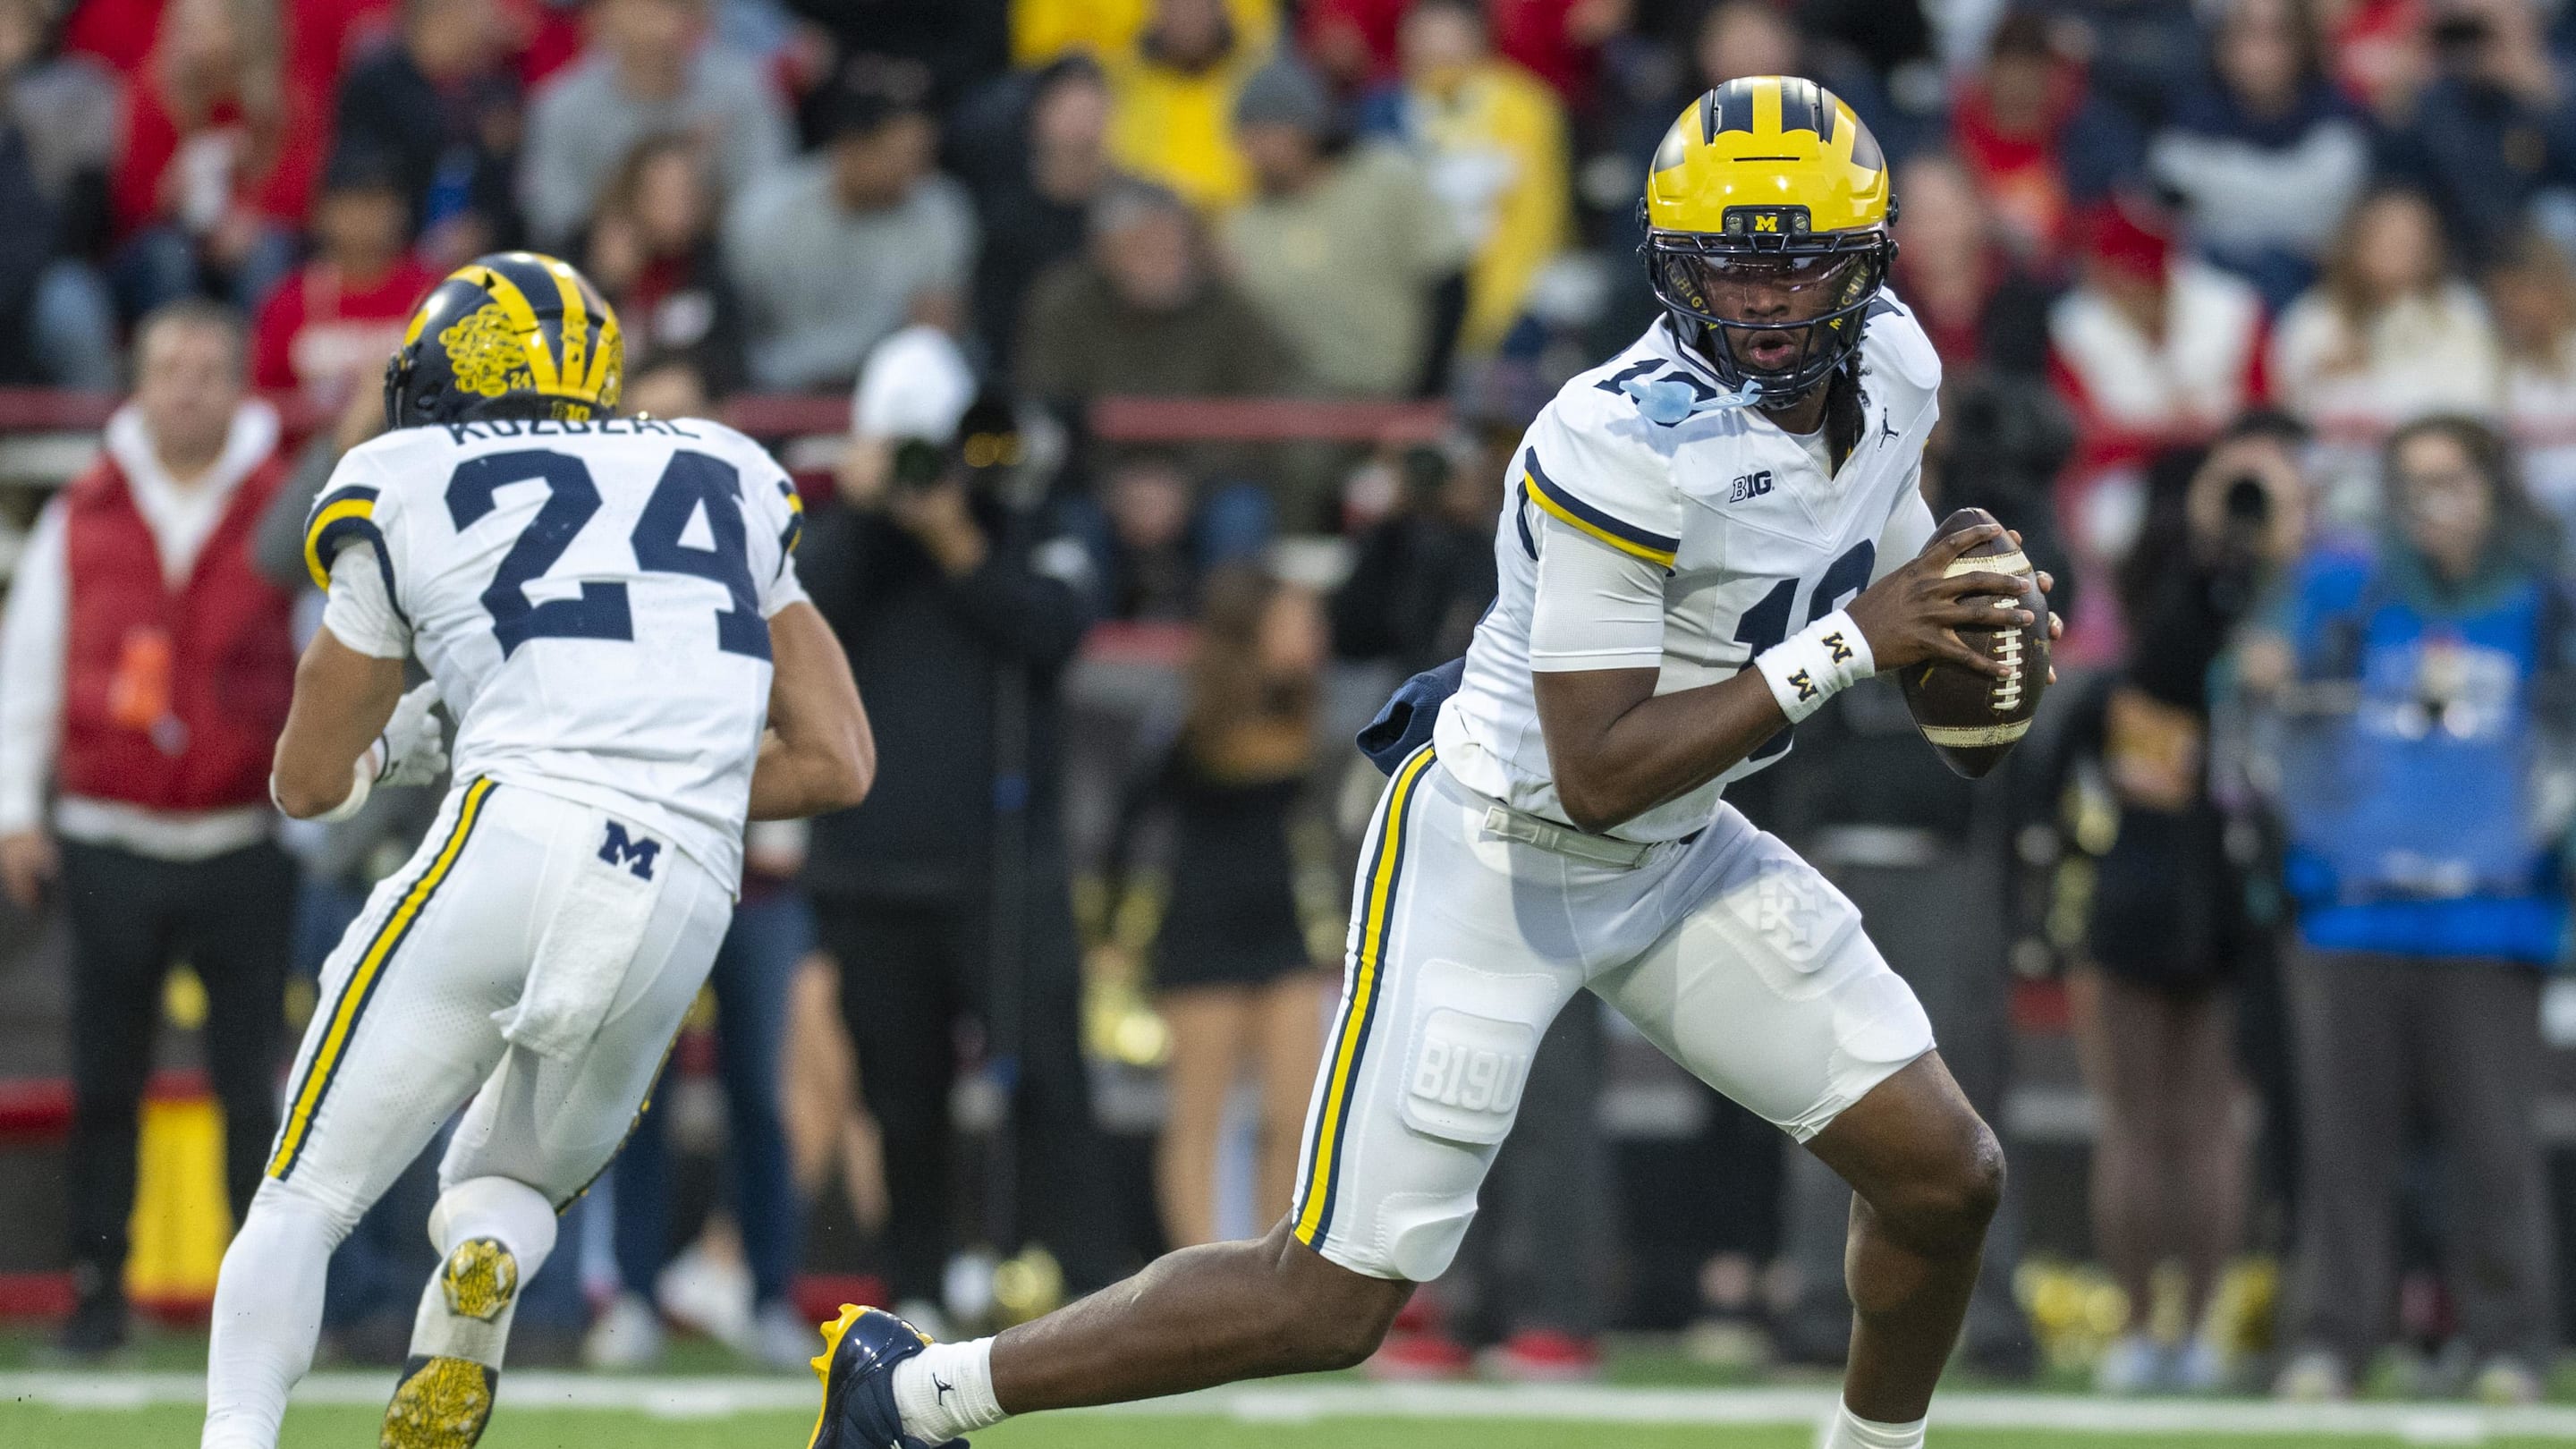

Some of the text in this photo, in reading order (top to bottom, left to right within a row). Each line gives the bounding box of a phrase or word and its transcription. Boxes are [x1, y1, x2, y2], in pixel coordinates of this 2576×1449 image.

[1755, 215, 1778, 233] M
[510, 371, 532, 390] 24
[444, 448, 775, 663] 24
[1821, 631, 1854, 665] M
[1787, 667, 1819, 703] M
[597, 819, 661, 882] M
